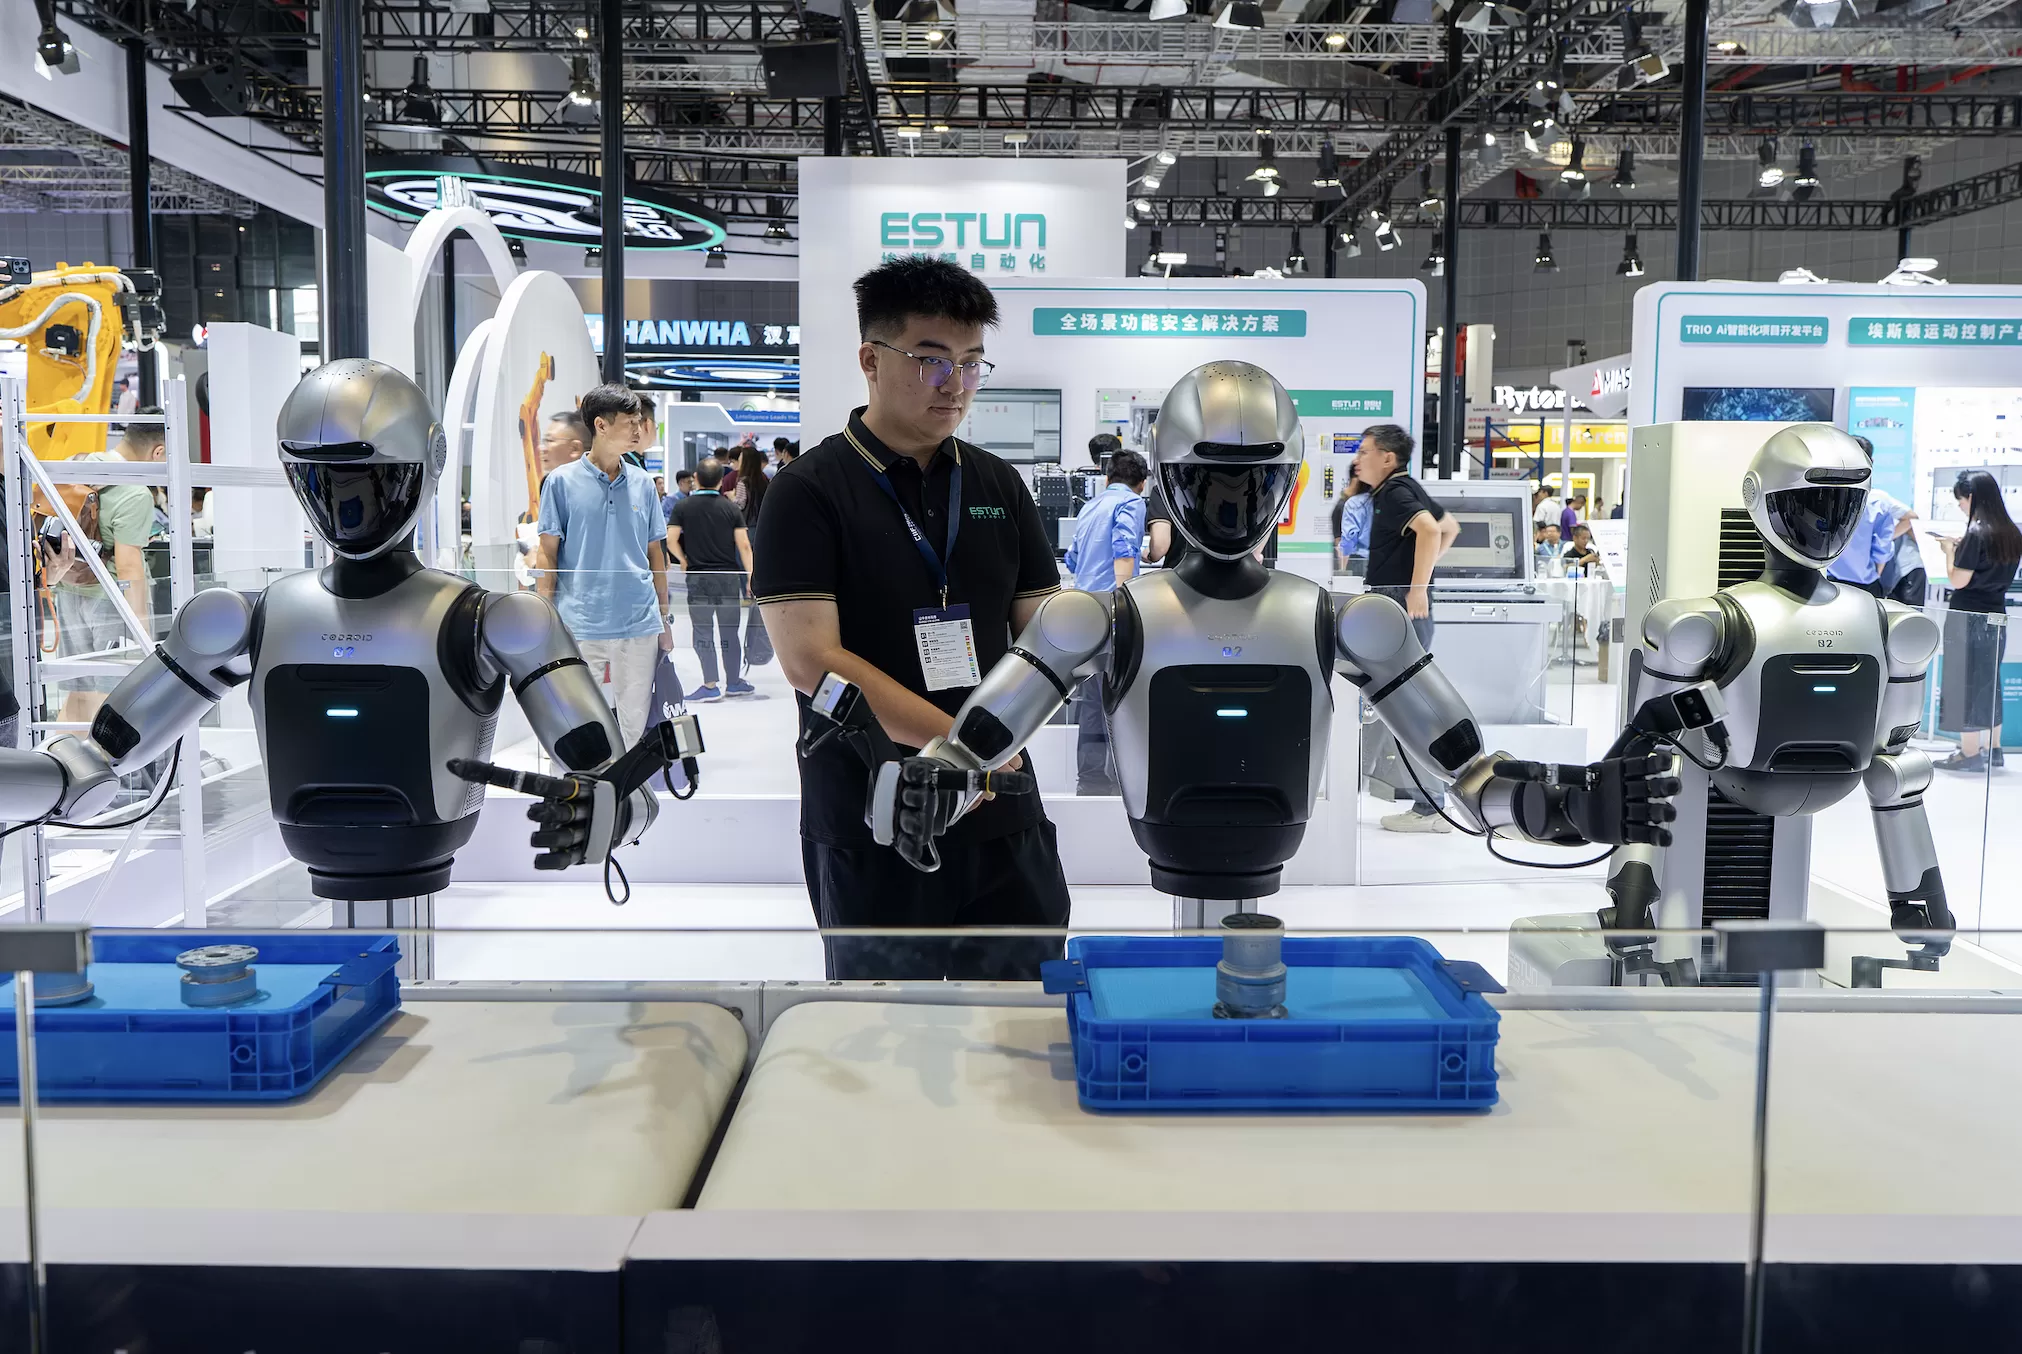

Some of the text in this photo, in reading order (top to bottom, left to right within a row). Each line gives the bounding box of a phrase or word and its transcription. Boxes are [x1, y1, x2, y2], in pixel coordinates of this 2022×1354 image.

[881, 212, 1046, 247] ESTUN
[1060, 313, 1280, 332] 全场景功能安全解决方案
[1685, 324, 1713, 335] TRIO
[624, 319, 751, 346] HANWHA
[969, 506, 1006, 515] ESTUN
